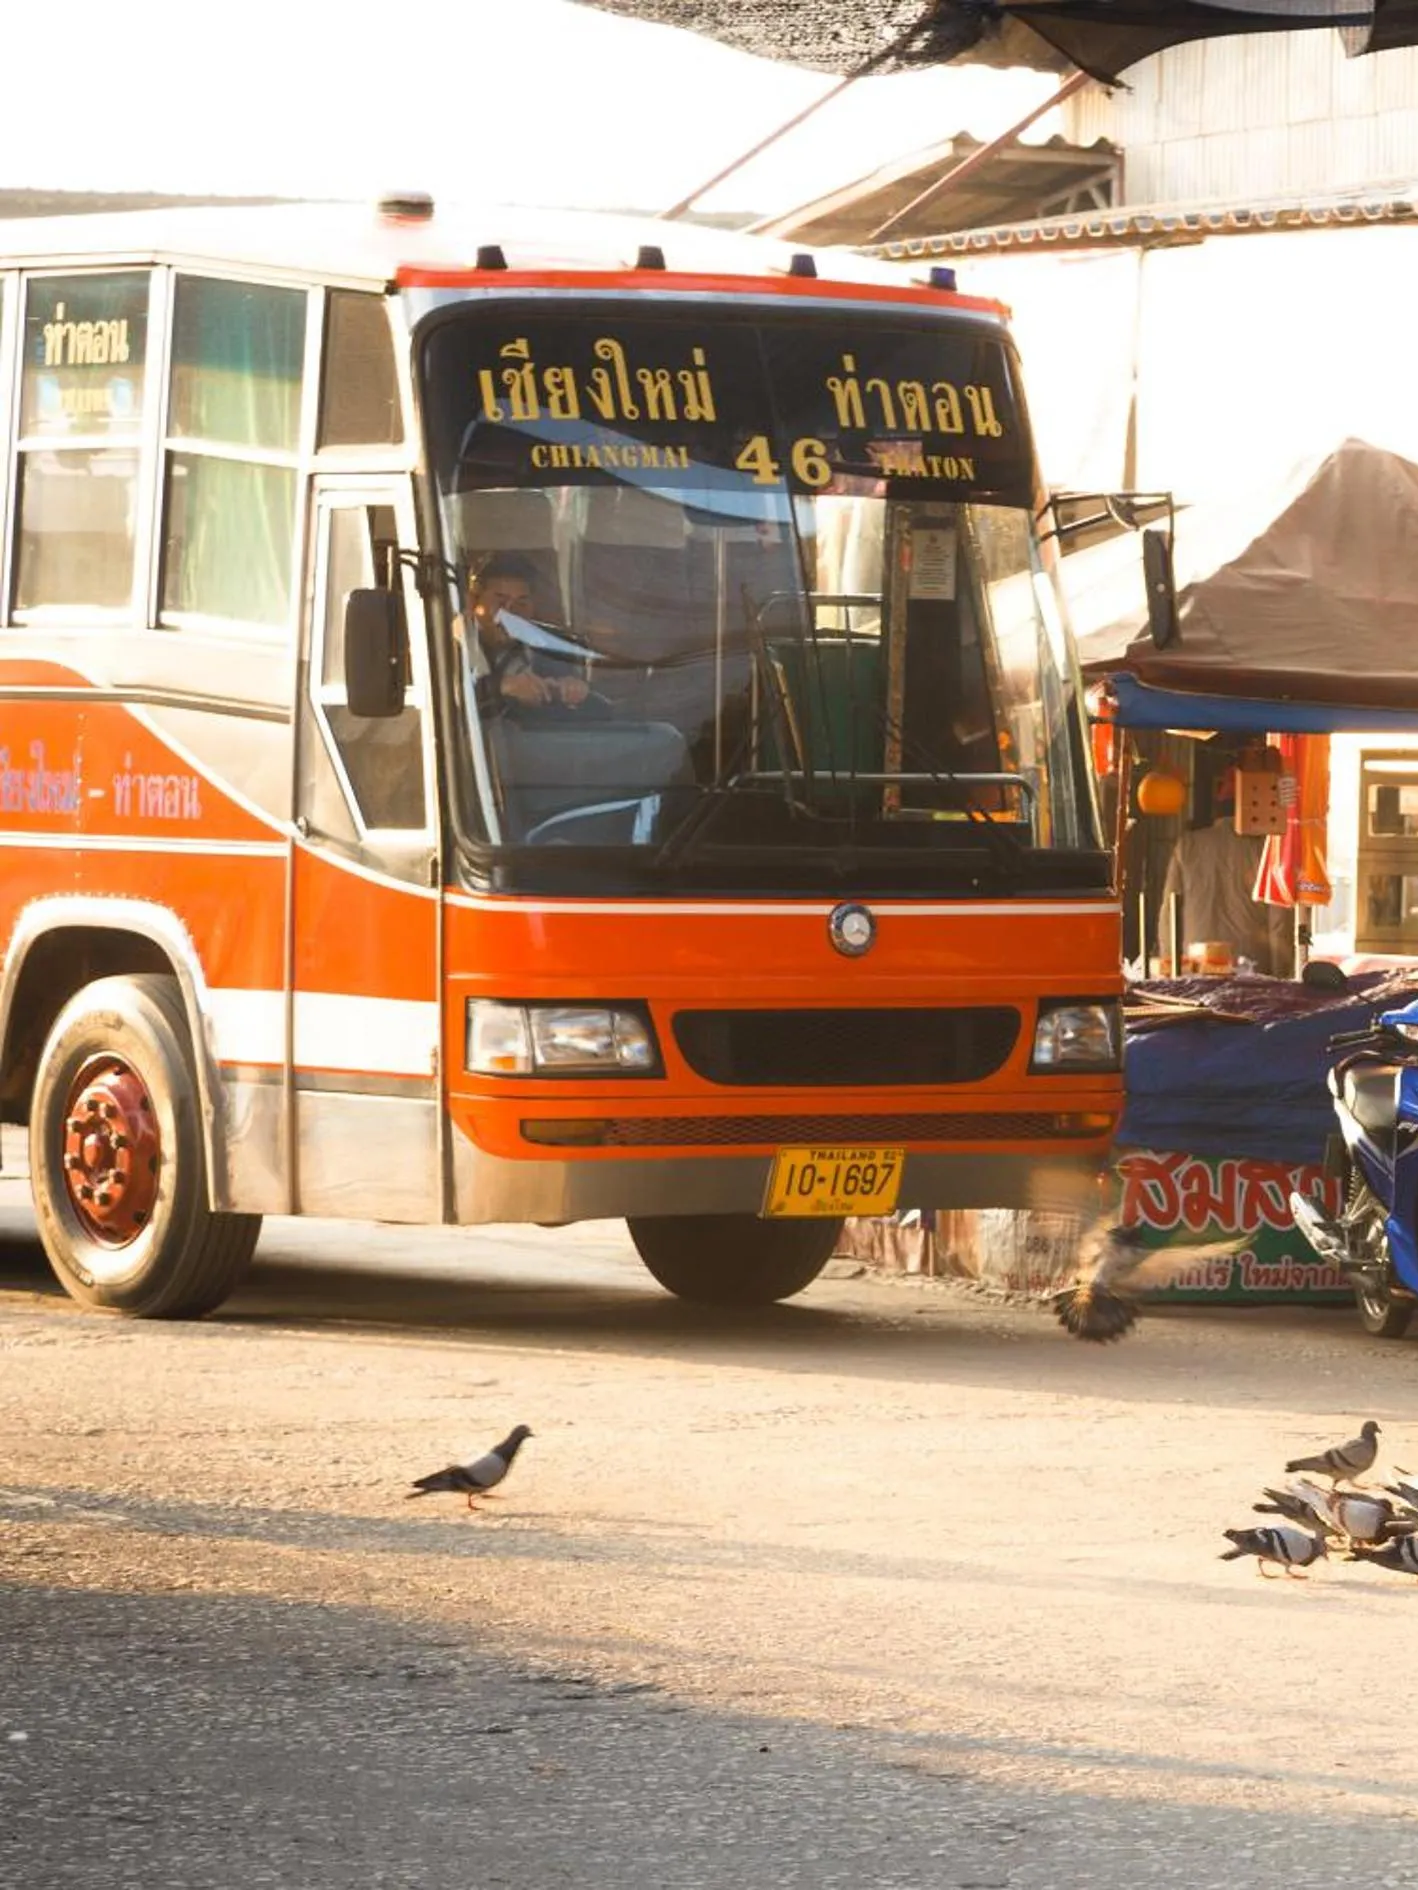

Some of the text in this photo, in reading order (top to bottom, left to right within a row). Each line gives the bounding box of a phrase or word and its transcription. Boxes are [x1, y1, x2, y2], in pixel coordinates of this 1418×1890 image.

[42, 301, 130, 367] ท่าตอน
[477, 336, 717, 422] เชียงใหม่
[826, 354, 1003, 438] ท่าตอน
[531, 444, 690, 470] CHIANGMAI
[735, 435, 833, 487] 46
[112, 751, 203, 820] ท่าตอน
[784, 1162, 897, 1197] 10-1697
[810, 1150, 877, 1161] THAILAND
